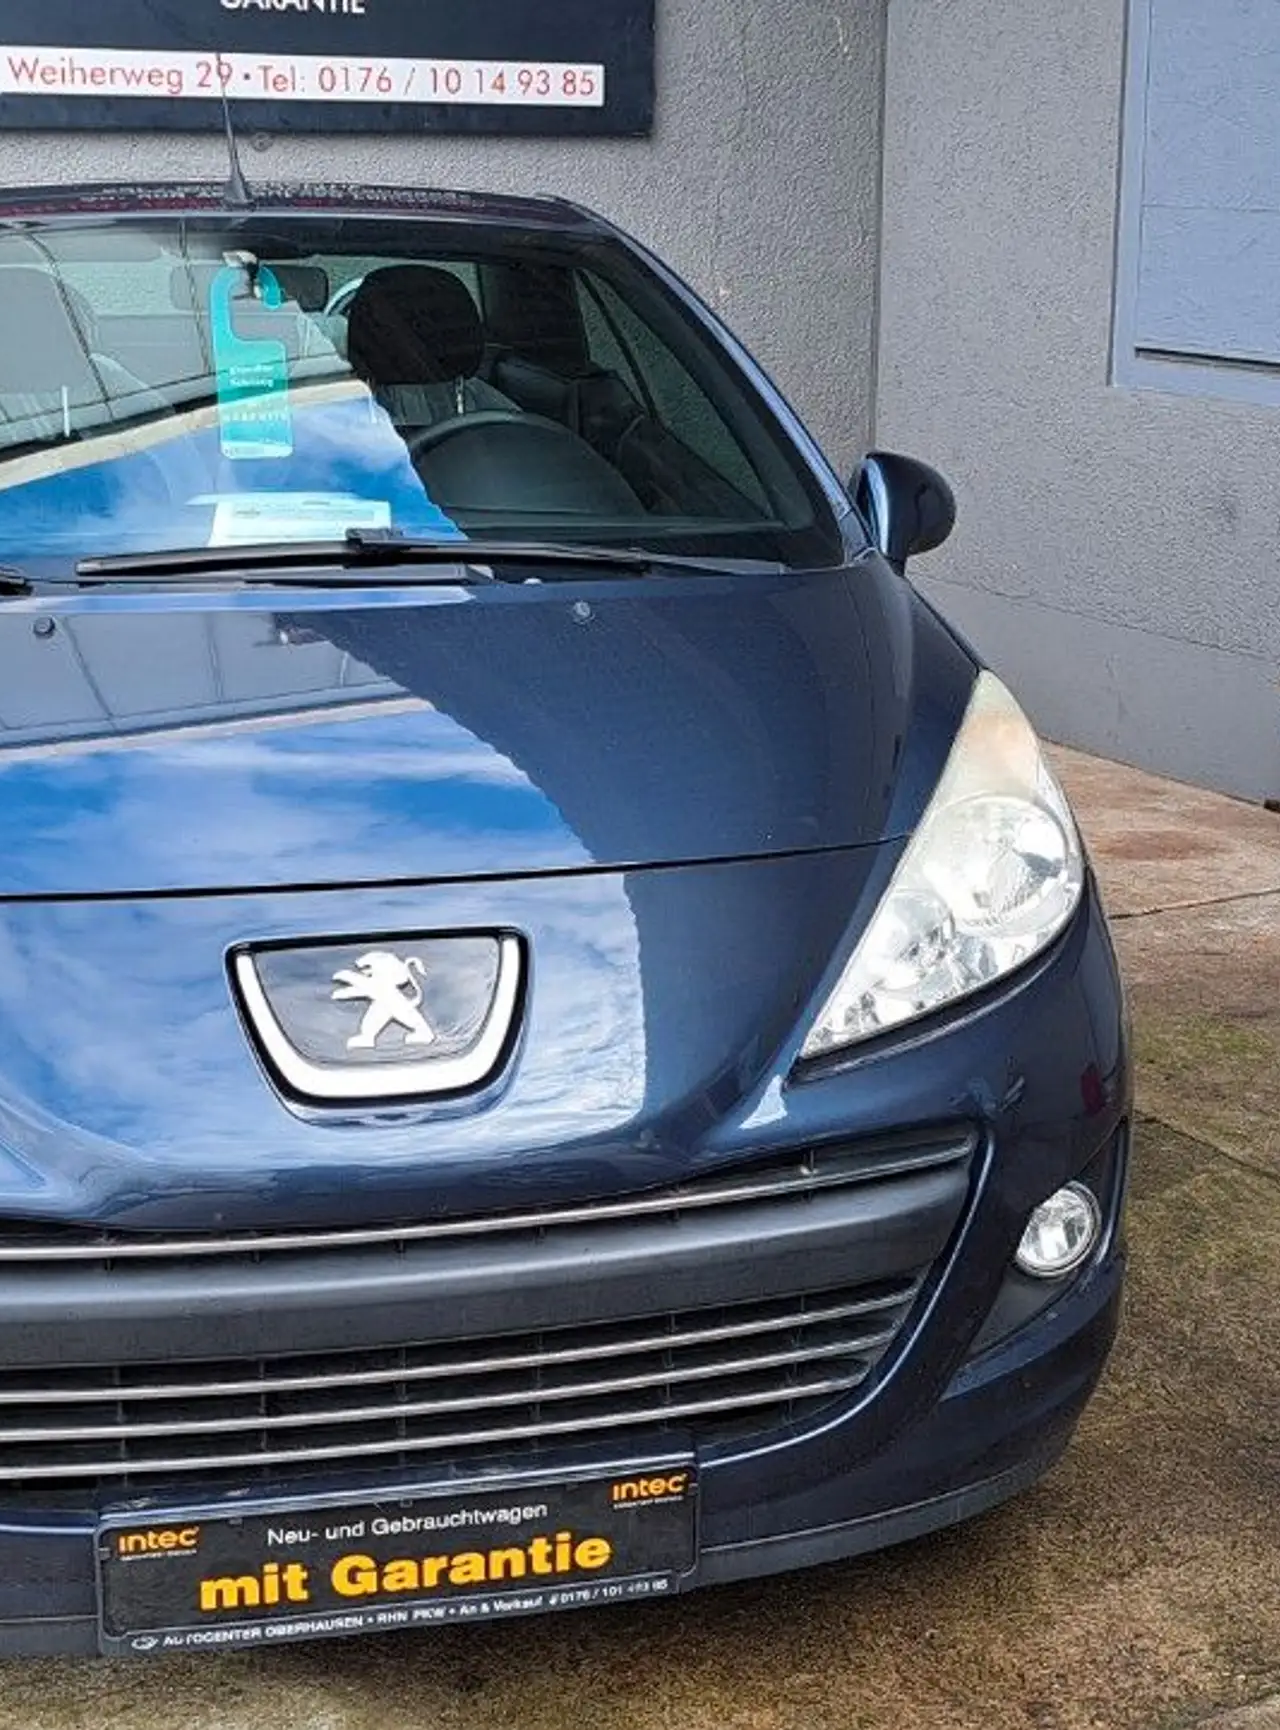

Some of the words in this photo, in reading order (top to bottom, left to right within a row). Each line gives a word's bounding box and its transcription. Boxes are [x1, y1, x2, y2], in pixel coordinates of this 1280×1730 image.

[7, 55, 184, 94] Weiherweg
[195, 60, 234, 88] 29
[258, 64, 306, 93] Tel:
[318, 66, 393, 93] 0176
[430, 67, 463, 95] 10
[475, 68, 508, 96] 14
[517, 69, 551, 96] 93
[562, 70, 596, 97] 85
[267, 1527, 319, 1546] Neu-
[324, 1514, 365, 1538] und
[371, 1502, 549, 1536] Gebrauchtwagen
[199, 1561, 309, 1611] mit
[331, 1529, 613, 1597] Garantie
